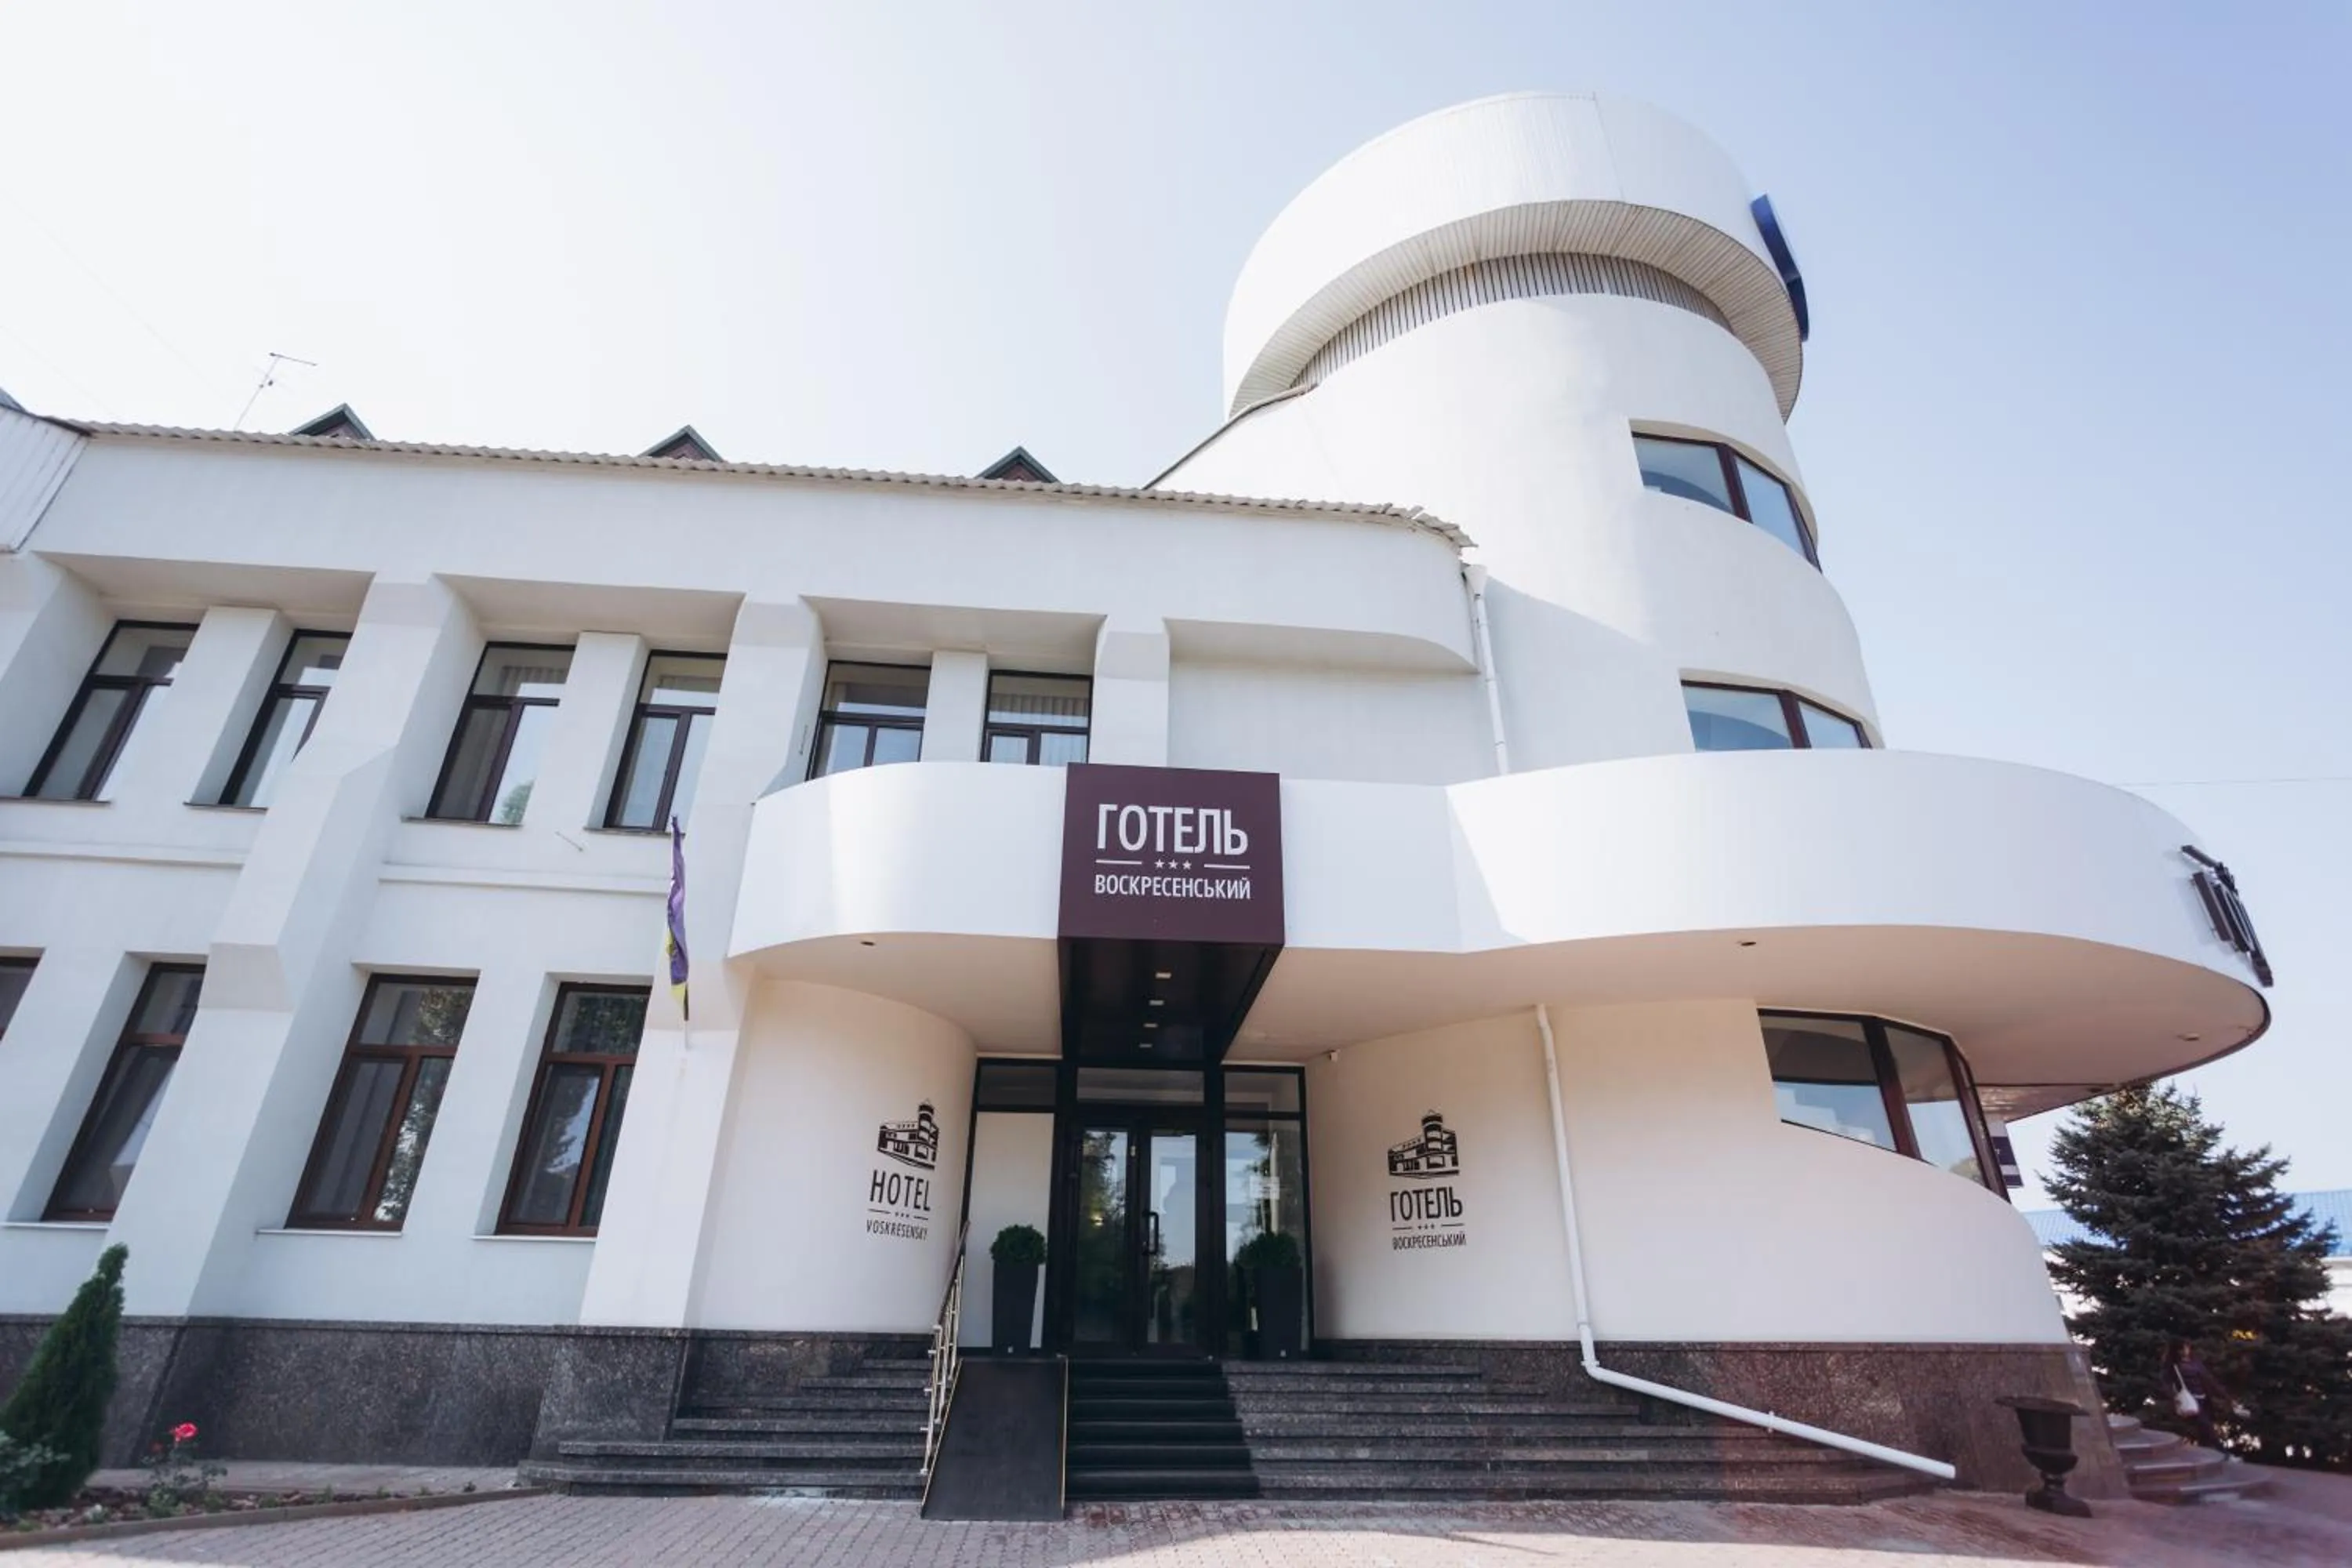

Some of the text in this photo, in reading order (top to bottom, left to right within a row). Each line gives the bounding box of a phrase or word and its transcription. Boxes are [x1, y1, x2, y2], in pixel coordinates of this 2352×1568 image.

[1098, 804, 1248, 855] ГОТЕЛЬ
[1094, 874, 1250, 899] ВОСКРЕСЕНСЬКИЙ
[869, 1169, 931, 1211] HOTEL
[1390, 1186, 1463, 1221] ГОТЕЛЬ
[1392, 1231, 1466, 1250] ВОСКРЕСЕНСЬКИЙ
